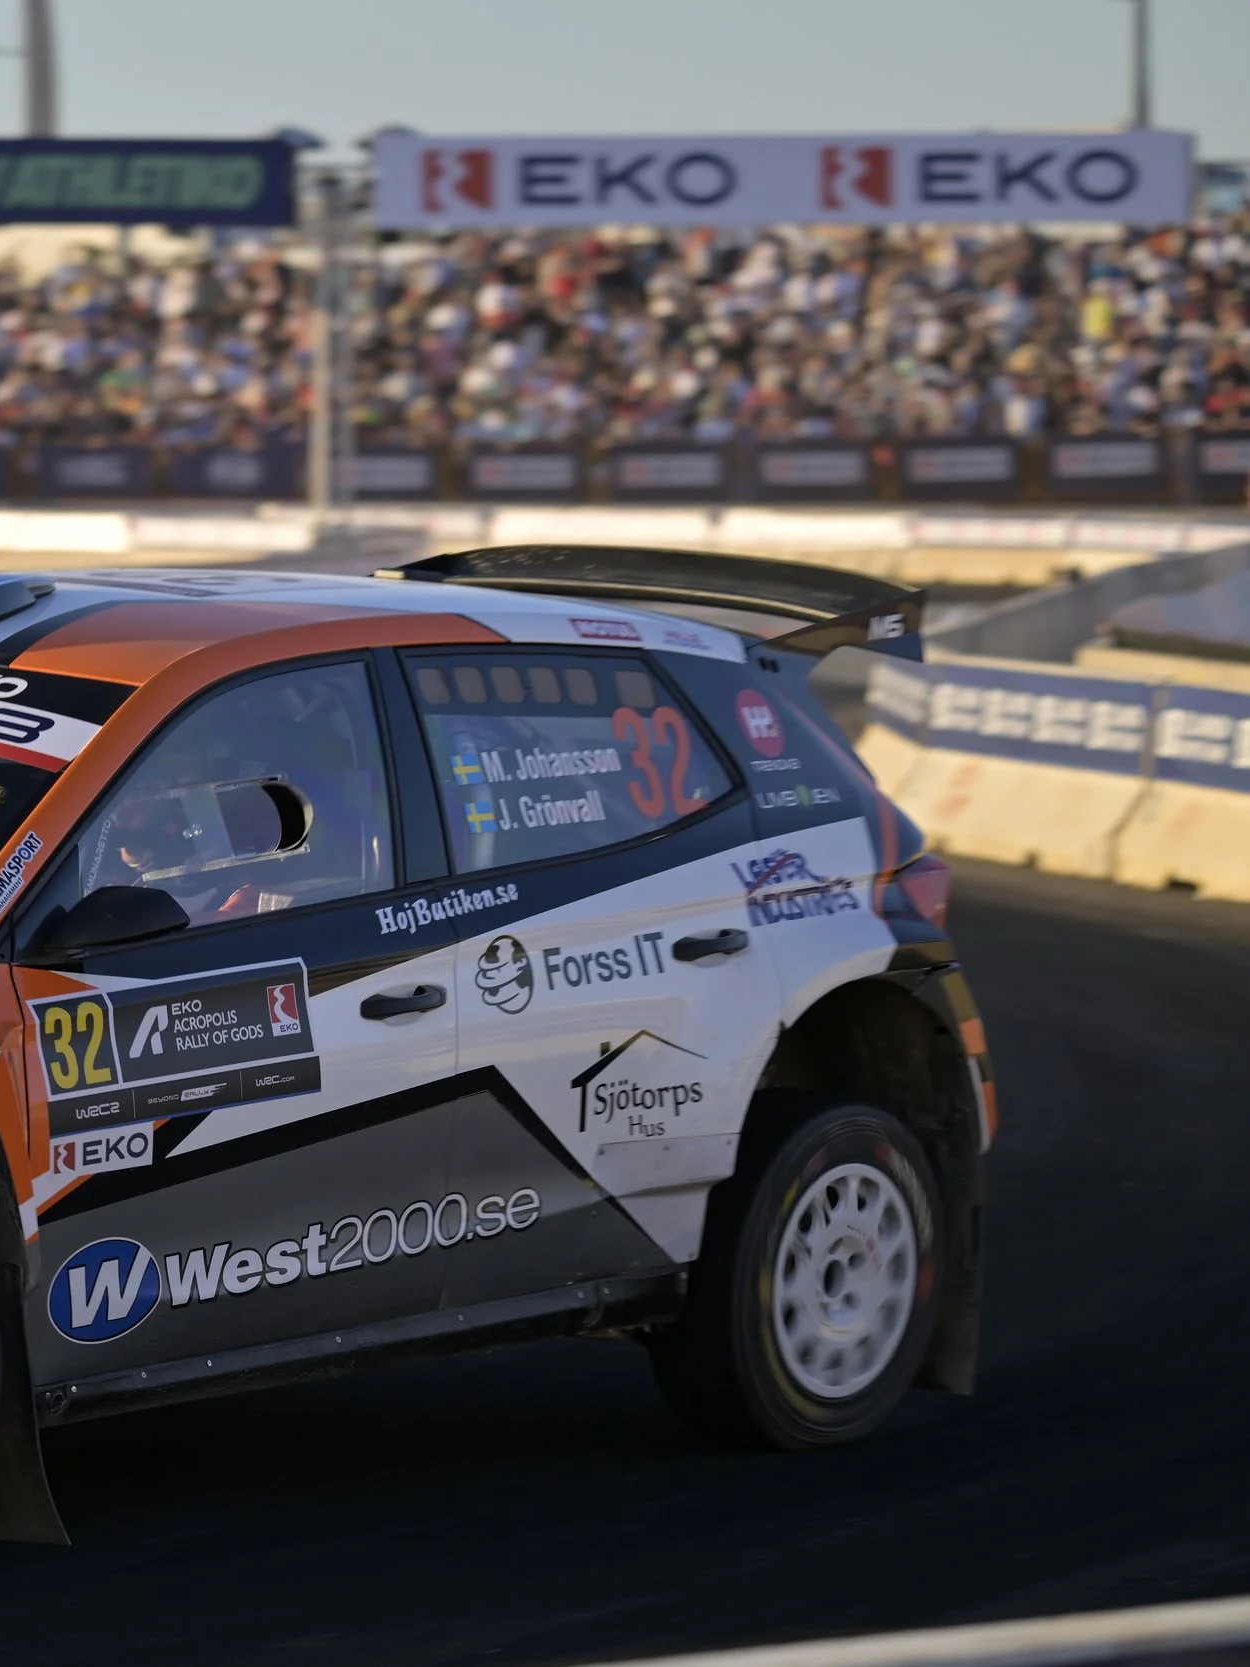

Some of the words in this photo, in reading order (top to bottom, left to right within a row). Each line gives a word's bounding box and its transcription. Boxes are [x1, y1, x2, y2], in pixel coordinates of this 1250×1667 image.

[517, 151, 738, 208] EKO
[917, 148, 1139, 205] EKO
[481, 751, 513, 783] M.
[515, 748, 623, 781] Johansson
[612, 706, 708, 819] 32
[499, 798, 519, 831] J.
[518, 789, 607, 829] Grönvall
[375, 883, 519, 935] HojButiken.se
[543, 946, 632, 991] Forss
[634, 931, 667, 976] IT
[171, 999, 202, 1016] EKO
[173, 1010, 238, 1034] ACROPOLIS
[279, 1022, 299, 1033] EKO
[44, 1001, 112, 1090] 32
[176, 1032, 210, 1052] RALLY
[212, 1029, 229, 1045] OF
[230, 1024, 264, 1042] GODS
[75, 1101, 120, 1120] WRC2
[594, 1079, 703, 1124] Sjötorps
[627, 1114, 667, 1138] Hus
[82, 1132, 149, 1167] EKO
[164, 1187, 542, 1308] West2000.se
